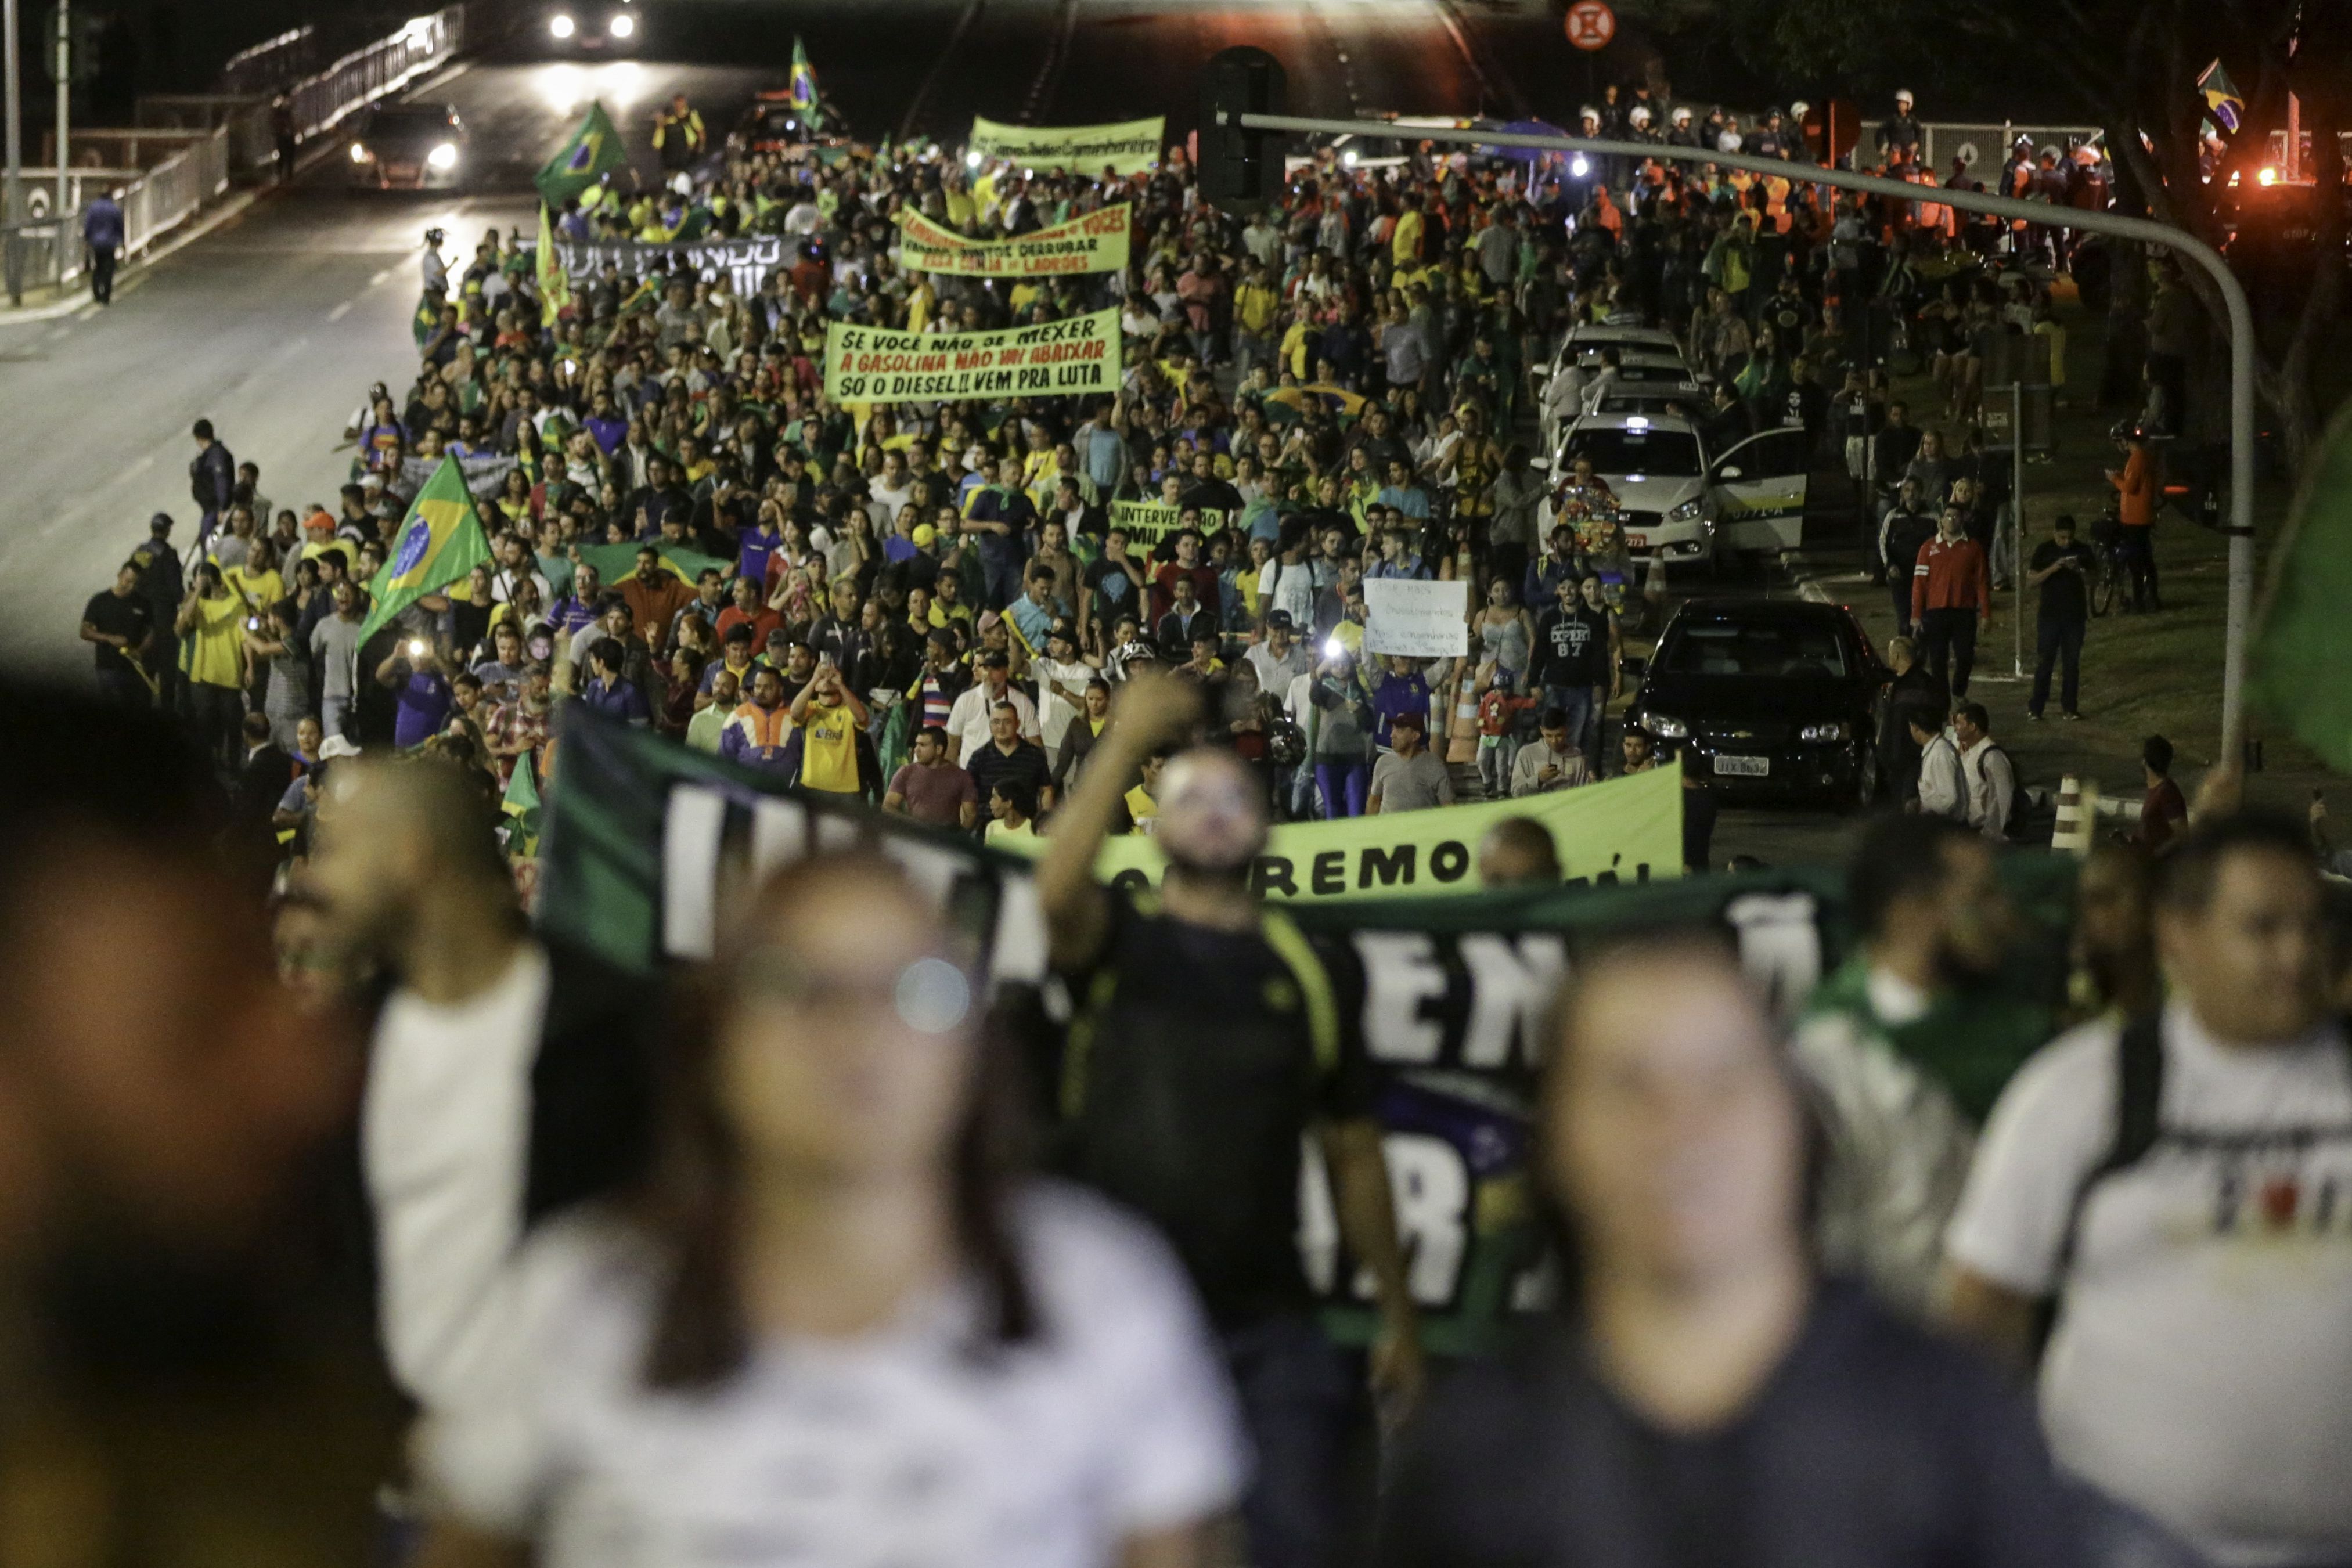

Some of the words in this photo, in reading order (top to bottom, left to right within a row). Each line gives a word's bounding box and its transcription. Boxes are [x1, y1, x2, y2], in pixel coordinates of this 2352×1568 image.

[1019, 237, 1098, 257] DERRUBAR
[842, 330, 865, 349] SE
[1017, 319, 1096, 345] MEXER
[840, 352, 853, 372] A
[858, 354, 947, 373] GASOLINA
[999, 348, 1026, 366] VAI
[1030, 340, 1105, 365] ABAIXAR
[873, 377, 886, 395] O
[974, 370, 1012, 391] VEM
[1018, 367, 1050, 390] PRA
[1057, 363, 1101, 386] LUTA
[1121, 506, 1216, 527] INTERVEAO
[1252, 841, 1469, 899] REMO
